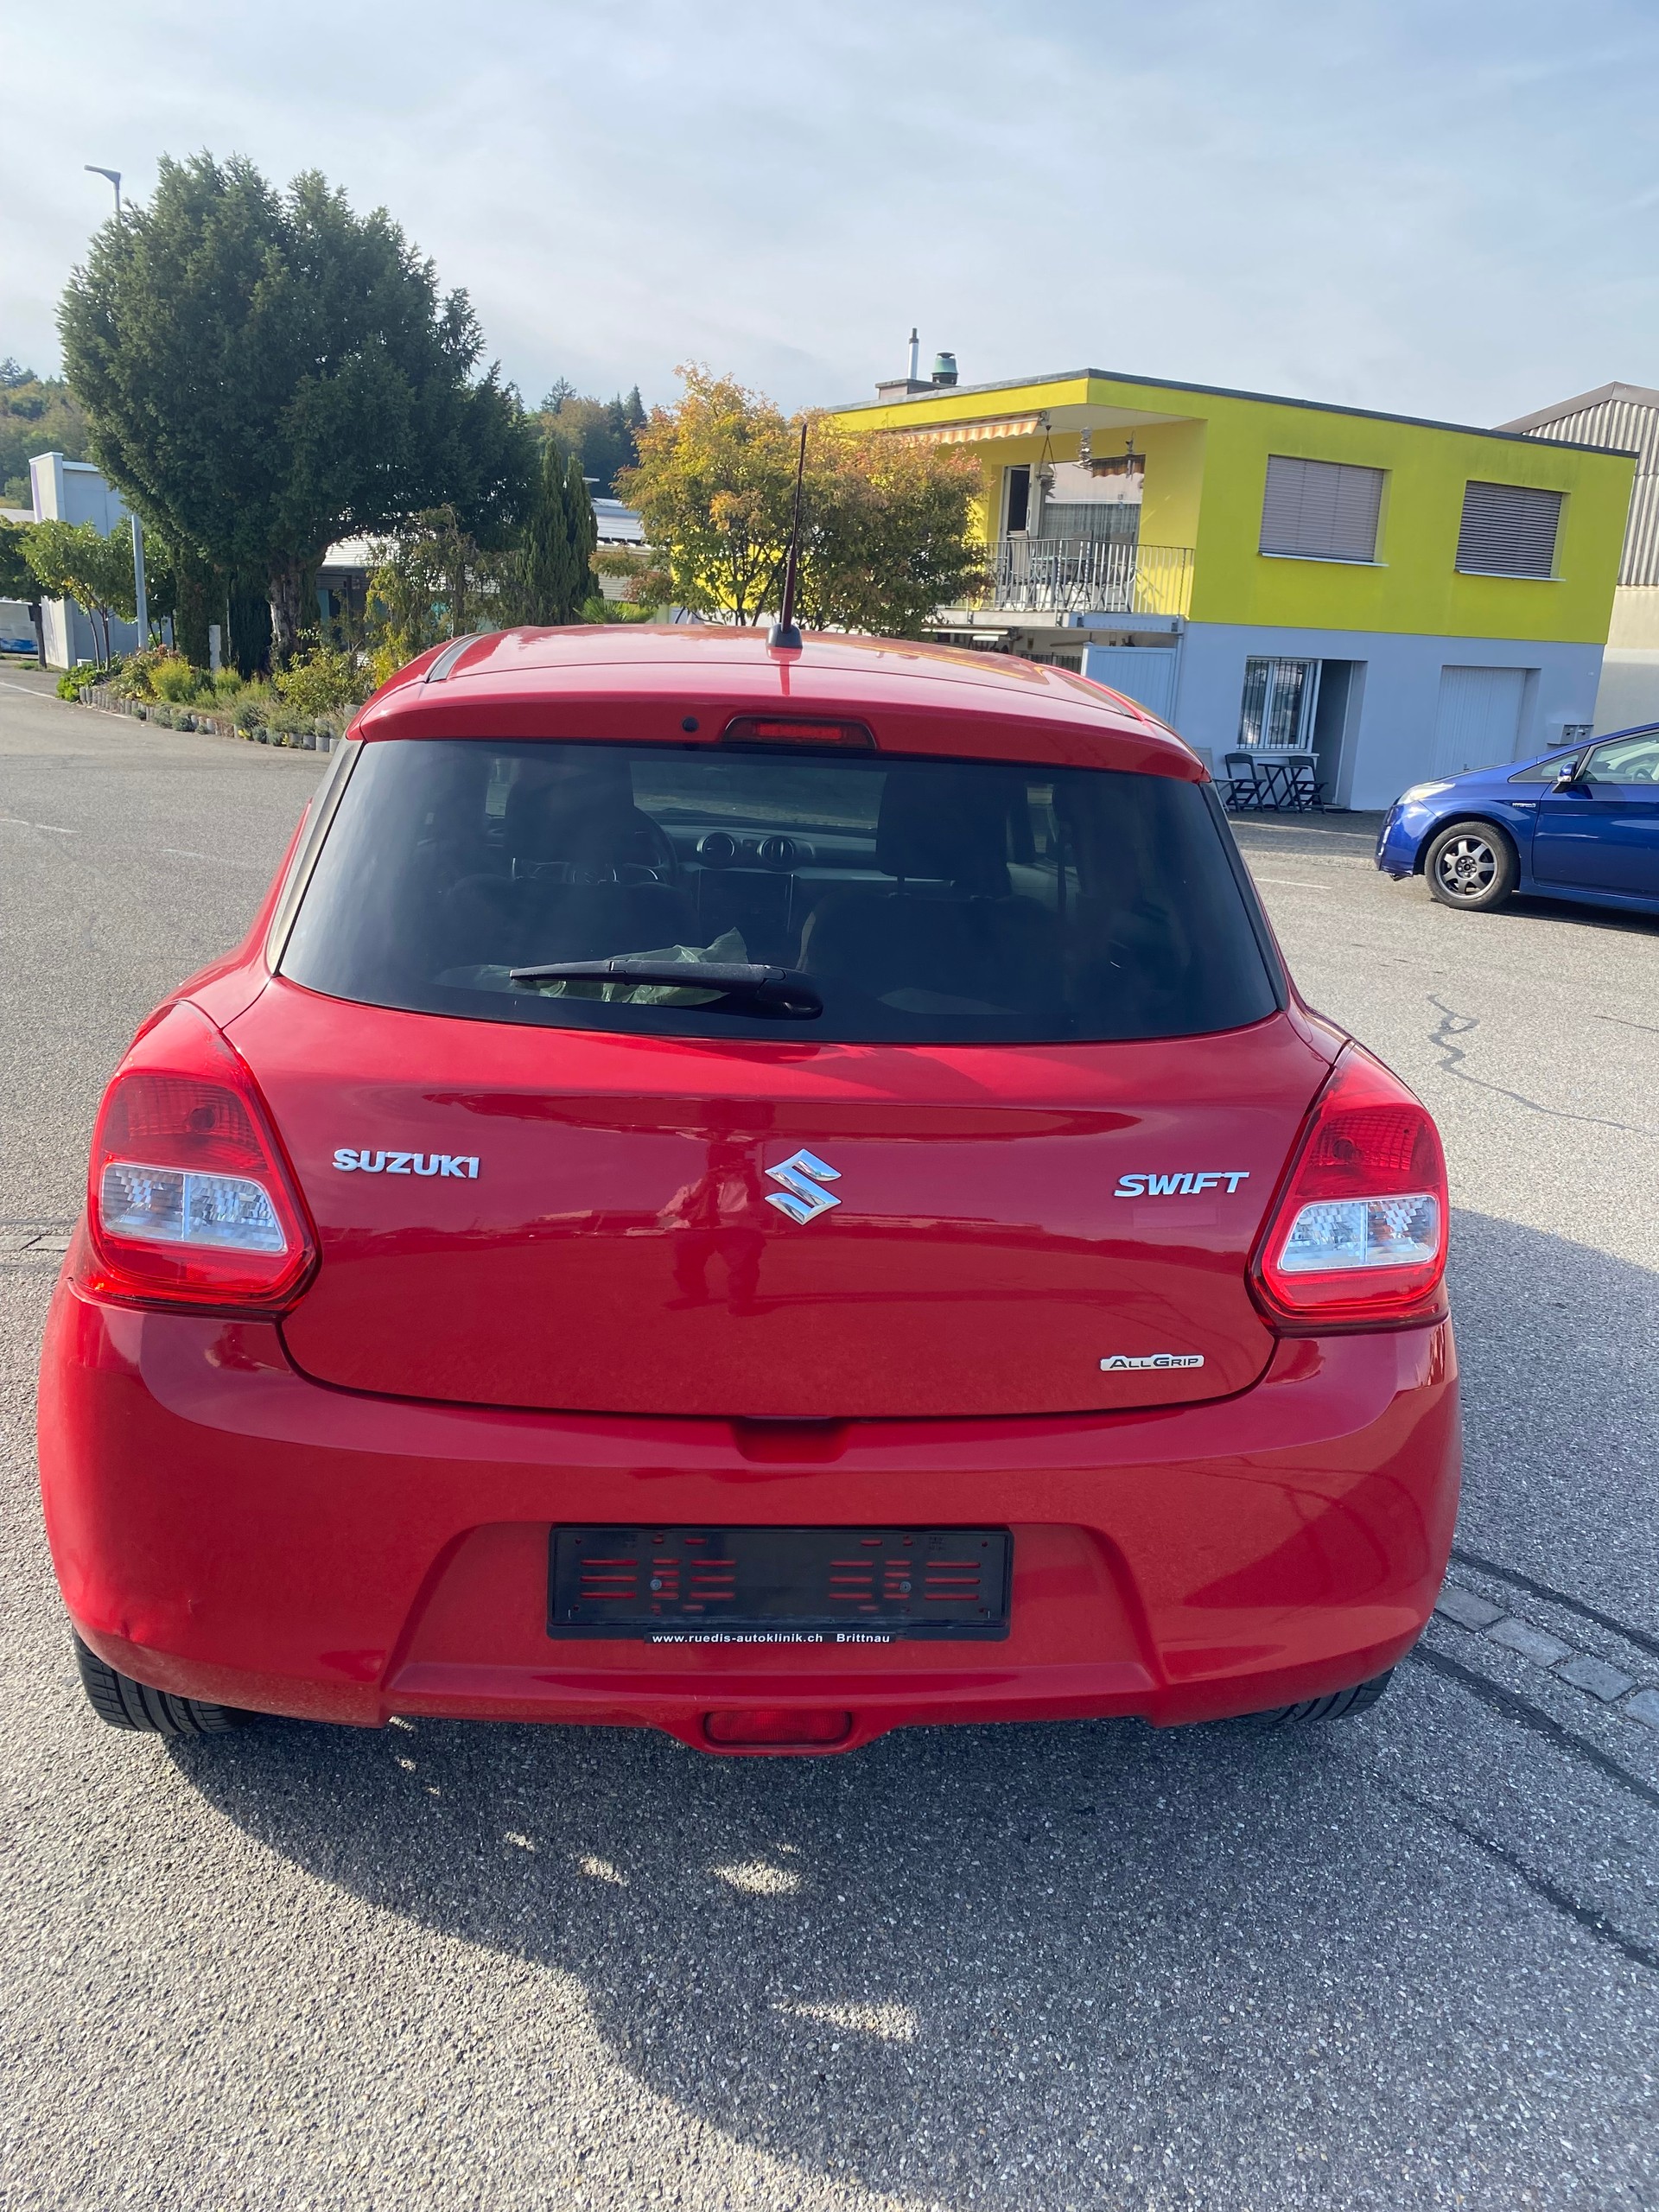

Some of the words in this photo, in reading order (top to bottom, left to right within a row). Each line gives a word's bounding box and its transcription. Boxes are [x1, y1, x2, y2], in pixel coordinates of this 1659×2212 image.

[332, 1148, 480, 1179] SUZUKI
[1114, 1171, 1250, 1198] SWIFT
[652, 1633, 823, 1643] www.ruedis-autoklinik.ch
[836, 1633, 890, 1643] Brittnau
